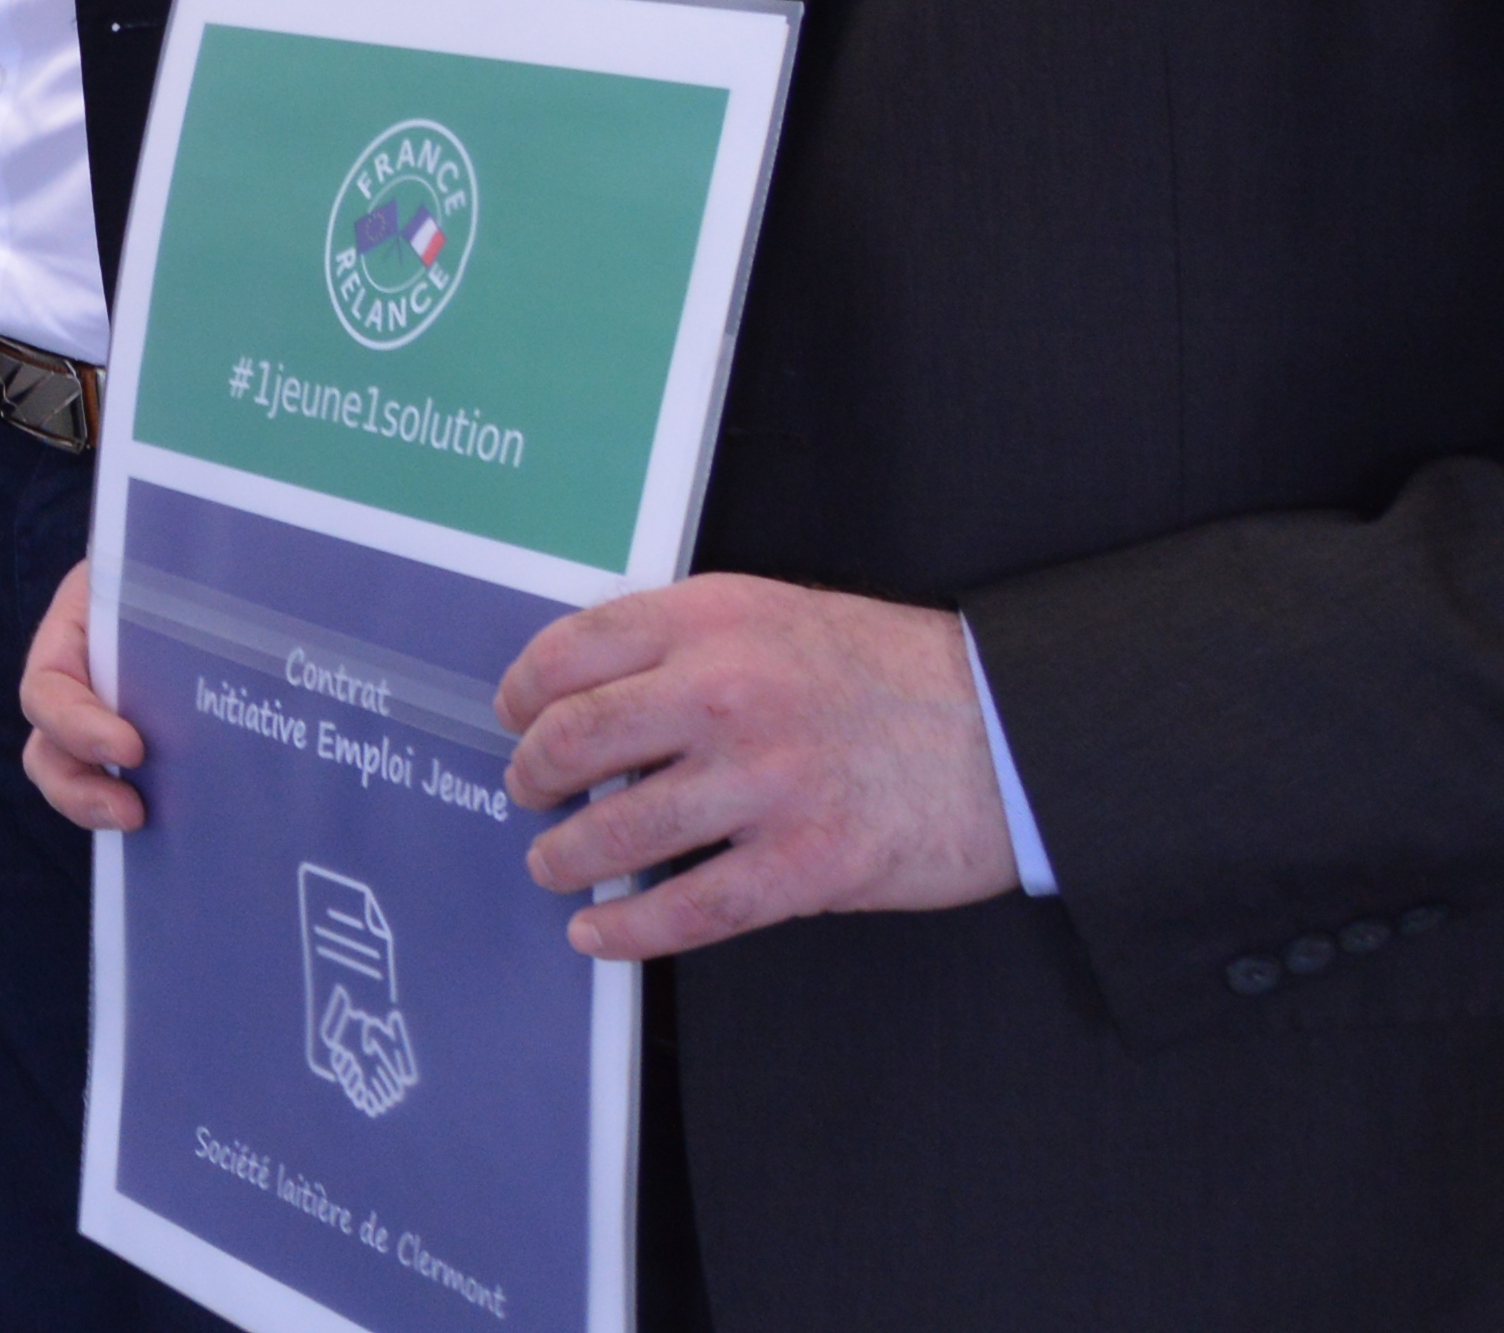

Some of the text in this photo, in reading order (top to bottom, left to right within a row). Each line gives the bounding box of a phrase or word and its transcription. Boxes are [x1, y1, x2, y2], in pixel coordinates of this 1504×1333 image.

[356, 138, 467, 217] FRANCE
[335, 246, 450, 333] RELANCE
[228, 355, 525, 468] #1jeune1solution
[285, 646, 392, 717] Contrat
[195, 675, 509, 823] Initiative Emploi Jeune
[194, 1125, 507, 1320] Société laitière de Clermont
